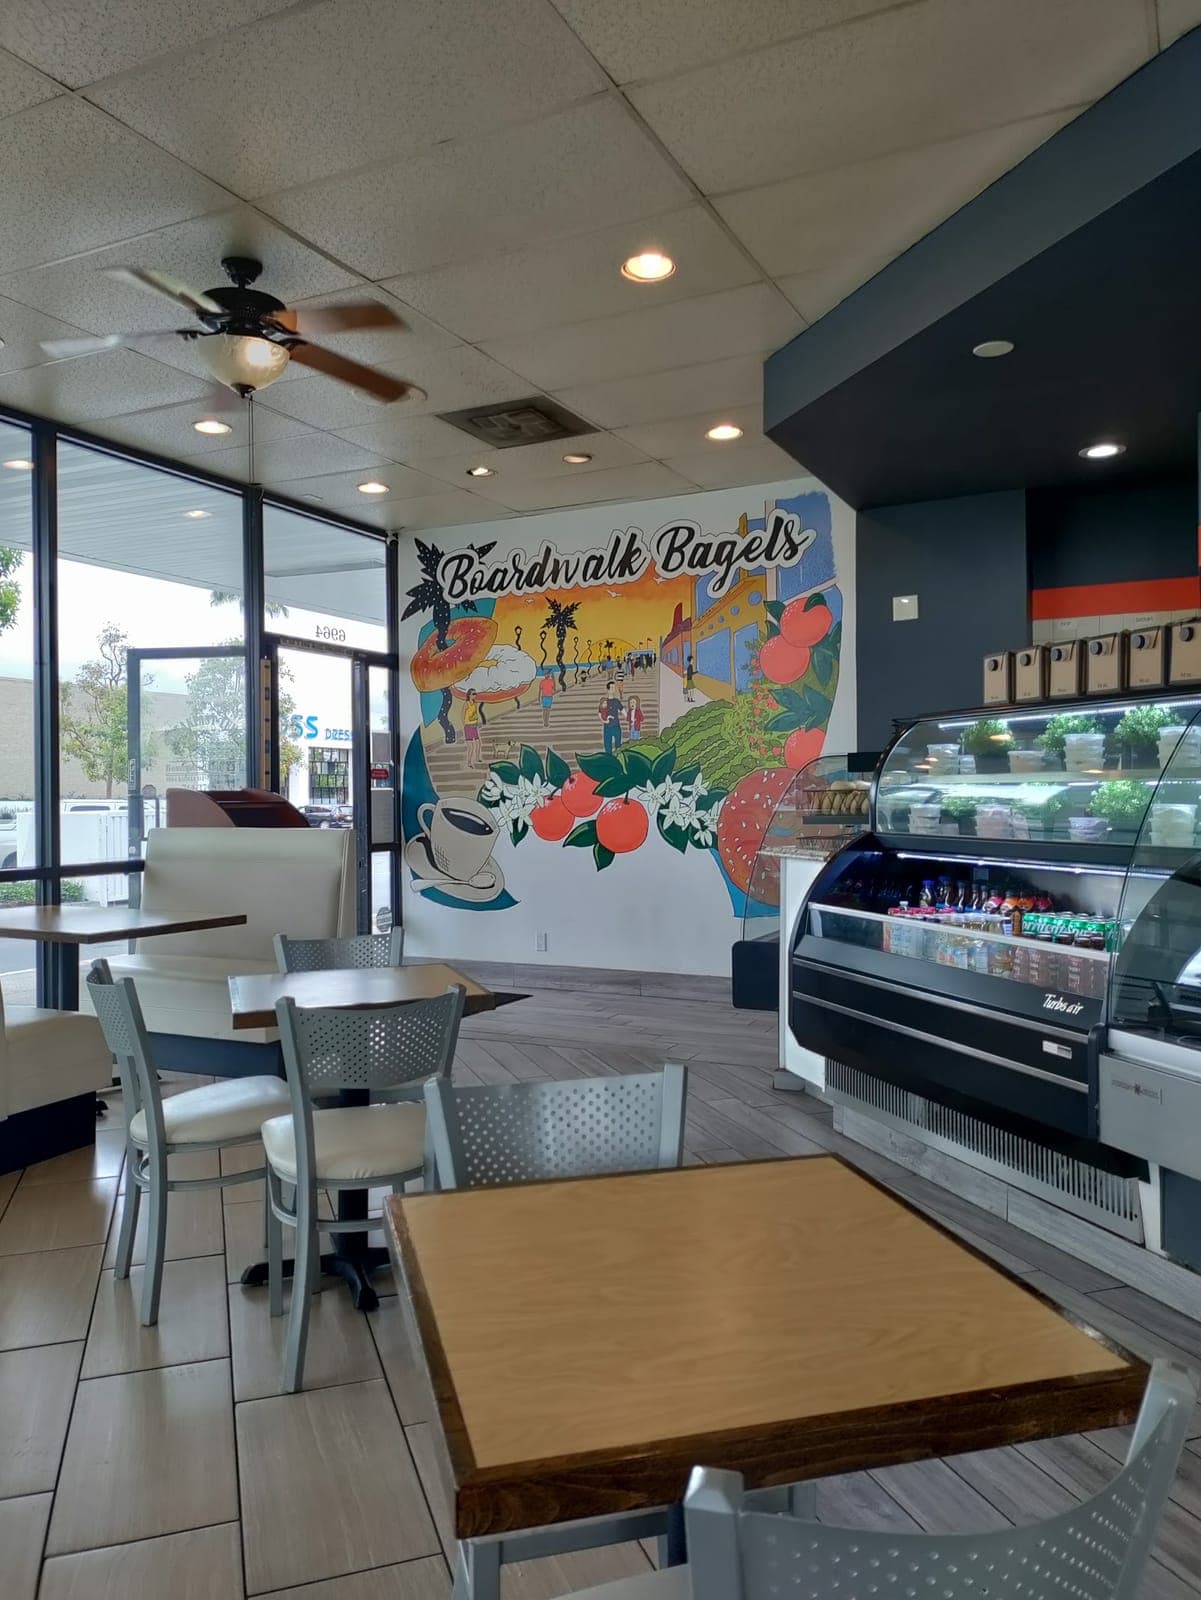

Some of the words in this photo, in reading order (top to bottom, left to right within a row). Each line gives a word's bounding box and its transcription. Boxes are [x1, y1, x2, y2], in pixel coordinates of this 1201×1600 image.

[441, 532, 647, 598] Boardwalk
[656, 515, 809, 592] Bagels
[281, 713, 319, 739] SS
[325, 727, 352, 741] DRES
[1066, 1002, 1084, 1015] air
